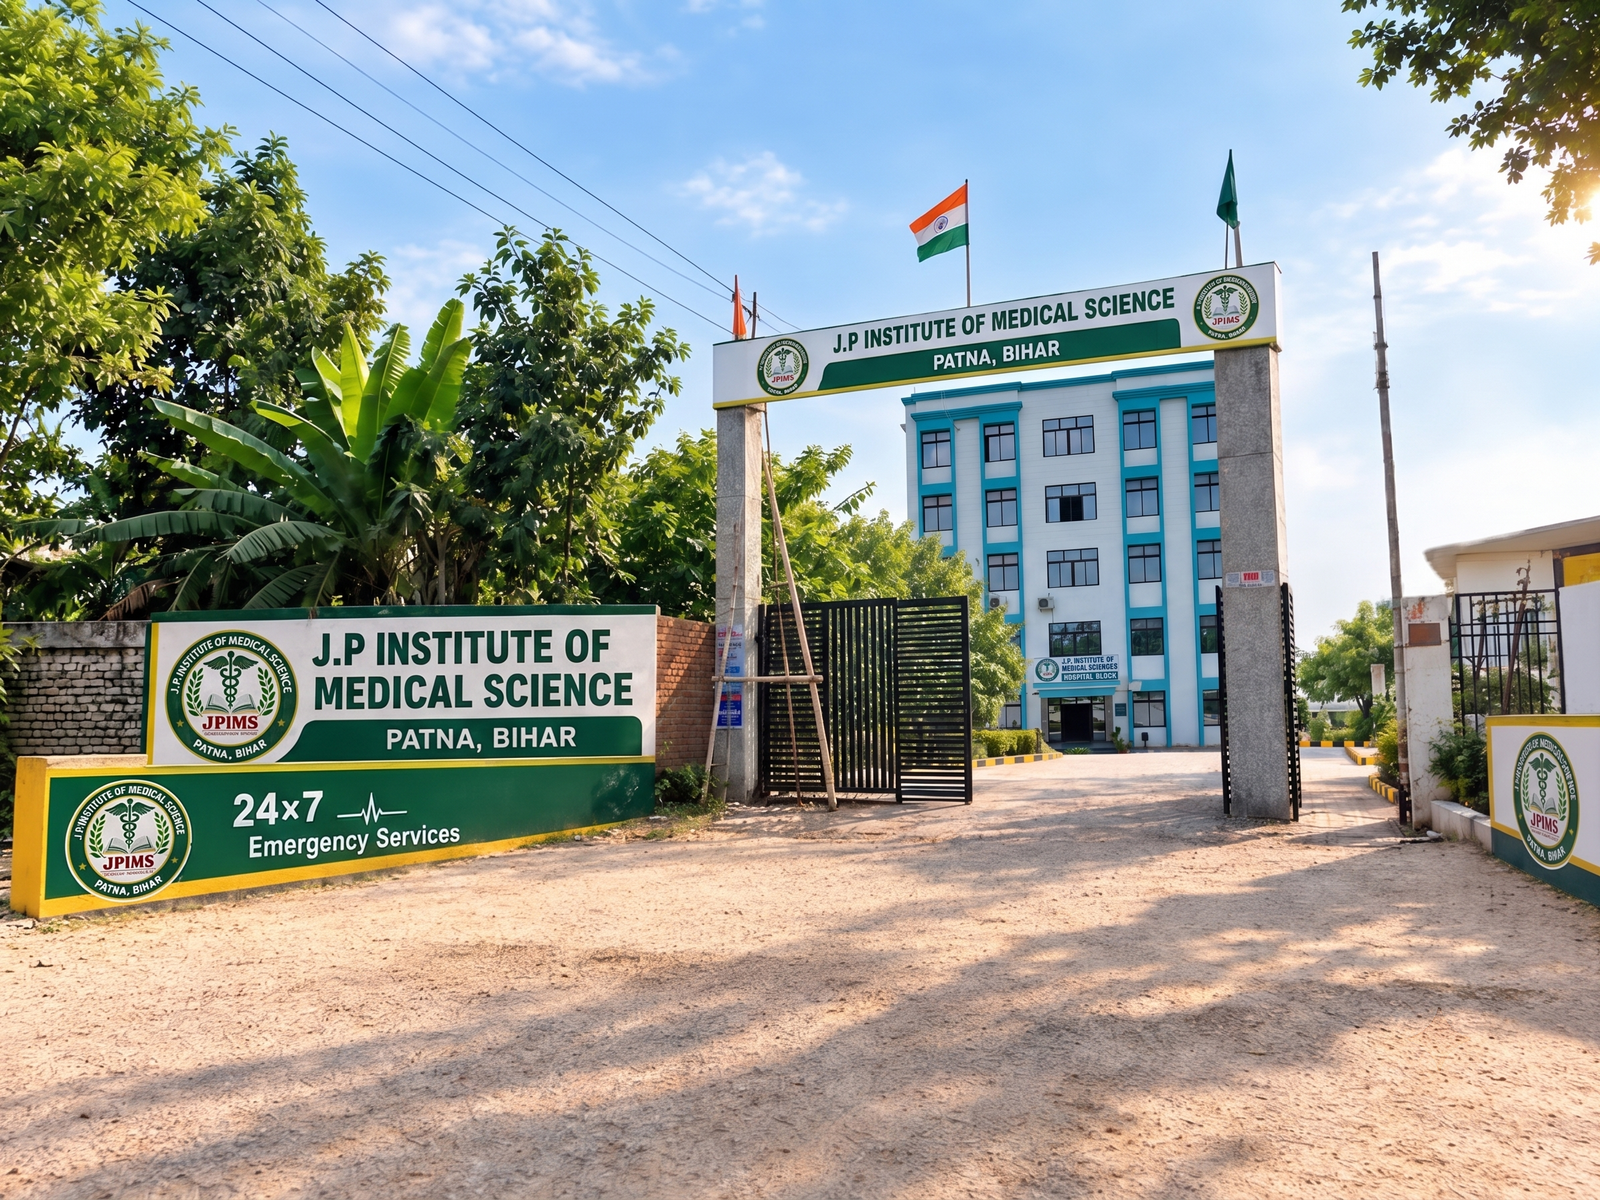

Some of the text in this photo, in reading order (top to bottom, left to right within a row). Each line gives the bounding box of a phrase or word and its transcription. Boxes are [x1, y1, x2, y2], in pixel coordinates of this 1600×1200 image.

[833, 331, 859, 354] J.P
[864, 317, 956, 349] INSTITUTE
[961, 313, 986, 335] OF
[991, 301, 1079, 332] MEDICAL
[1084, 287, 1175, 319] SCIENCE
[933, 340, 1060, 371] PATNA, BIHAR
[312, 629, 611, 667] J.P INSTITUTE OF
[1074, 656, 1104, 664] INSTITUTE
[214, 636, 227, 646] OF
[228, 635, 271, 659] MEDICAL
[268, 653, 293, 694] SCIENCE
[1062, 664, 1088, 672] MEDICAL
[314, 672, 634, 710] MEDICAL SCIENCE
[202, 715, 259, 730] JPIMS
[235, 738, 268, 759] BIHAR
[386, 726, 577, 753] PATNA, BIHAR
[114, 786, 127, 796] OF
[128, 785, 166, 805] MEDICAL
[164, 801, 185, 836] SCIENCE
[1530, 812, 1559, 834] JPIMS
[249, 824, 461, 860] Emergency Services
[102, 854, 155, 871] JPIMS
[94, 875, 164, 897] PATNA, BIHAR
